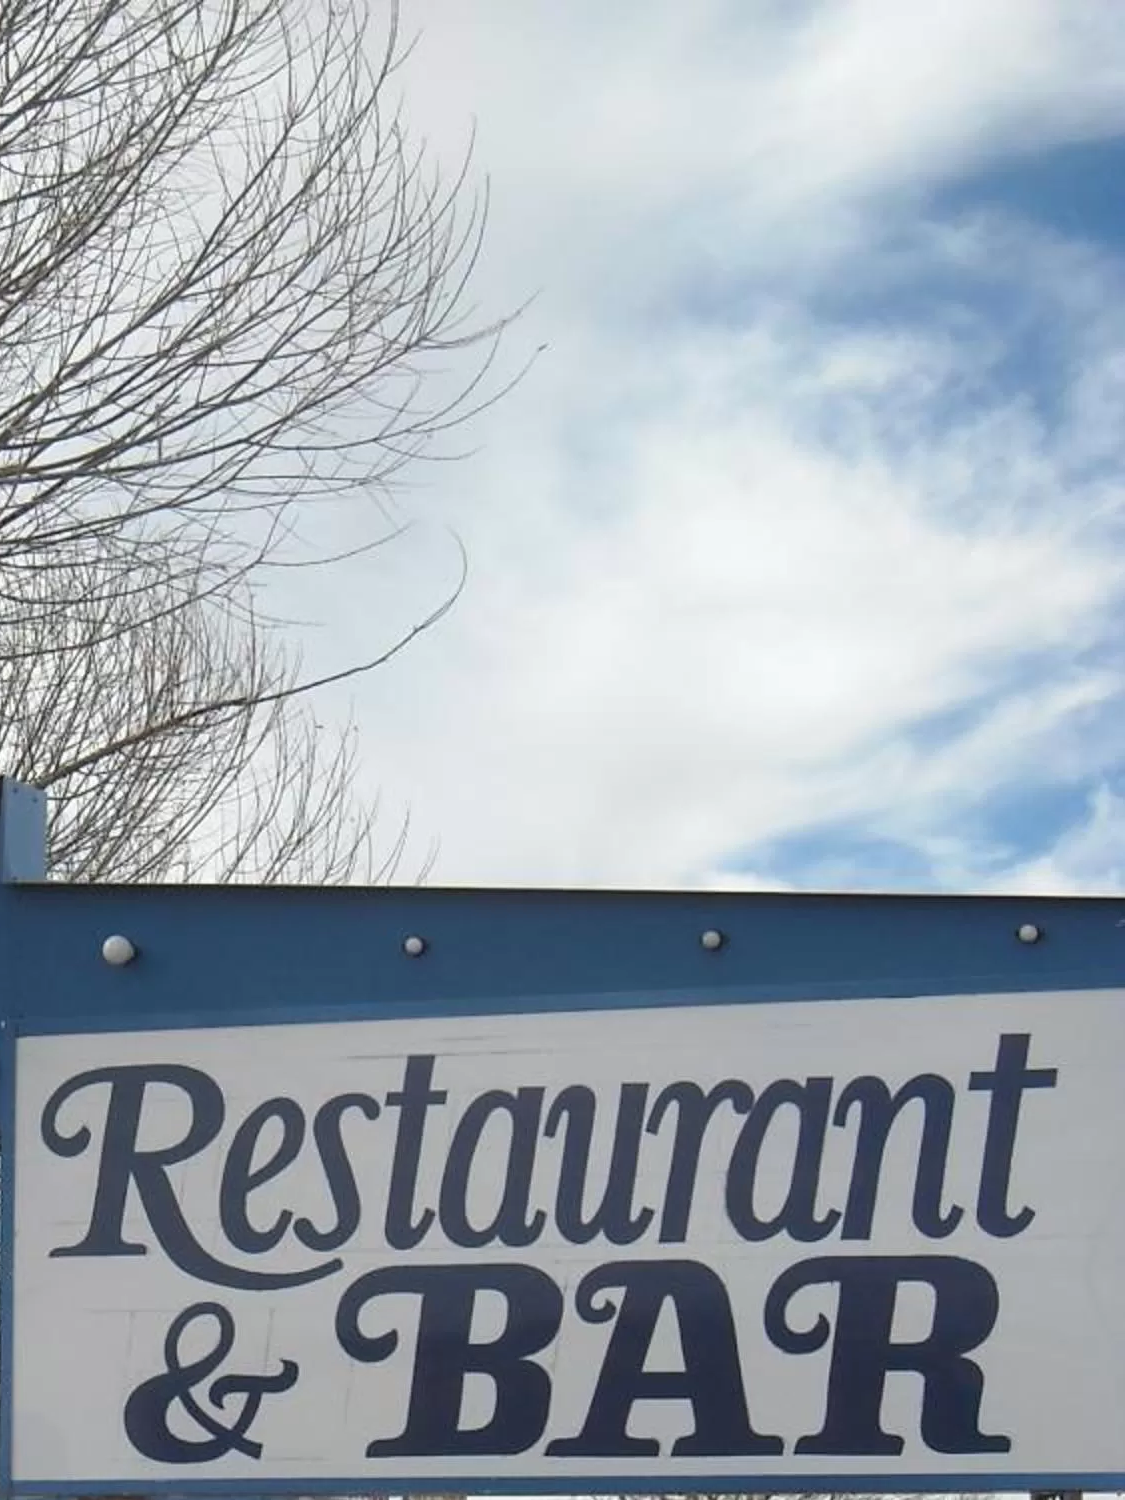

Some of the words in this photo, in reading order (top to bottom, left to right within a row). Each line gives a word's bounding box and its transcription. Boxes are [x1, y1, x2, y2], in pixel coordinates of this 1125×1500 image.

[41, 1033, 1058, 1290] Restaurant
[123, 1301, 299, 1464] &
[335, 1255, 1012, 1459] BAR
